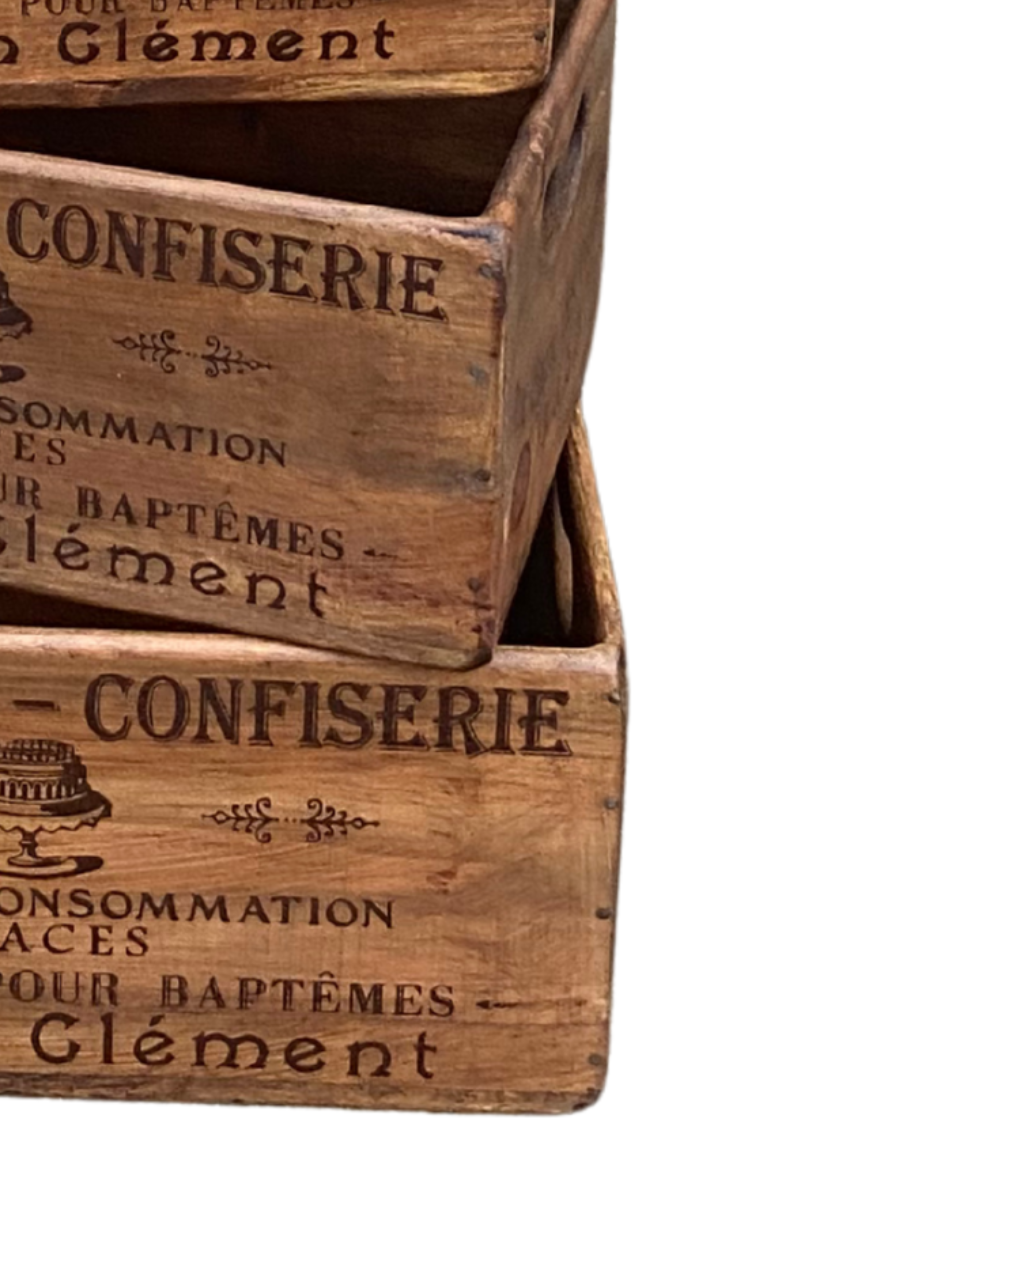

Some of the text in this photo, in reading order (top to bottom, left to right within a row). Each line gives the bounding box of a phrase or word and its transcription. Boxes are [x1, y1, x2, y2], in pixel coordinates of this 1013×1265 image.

[56, 16, 396, 67] Clément
[7, 197, 448, 323] CONFISERIE
[76, 484, 344, 563] BAPTÊMES
[82, 673, 572, 758] CONFISERIE
[160, 969, 455, 1018] BAPTÊMES
[31, 1009, 439, 1081] Clément
